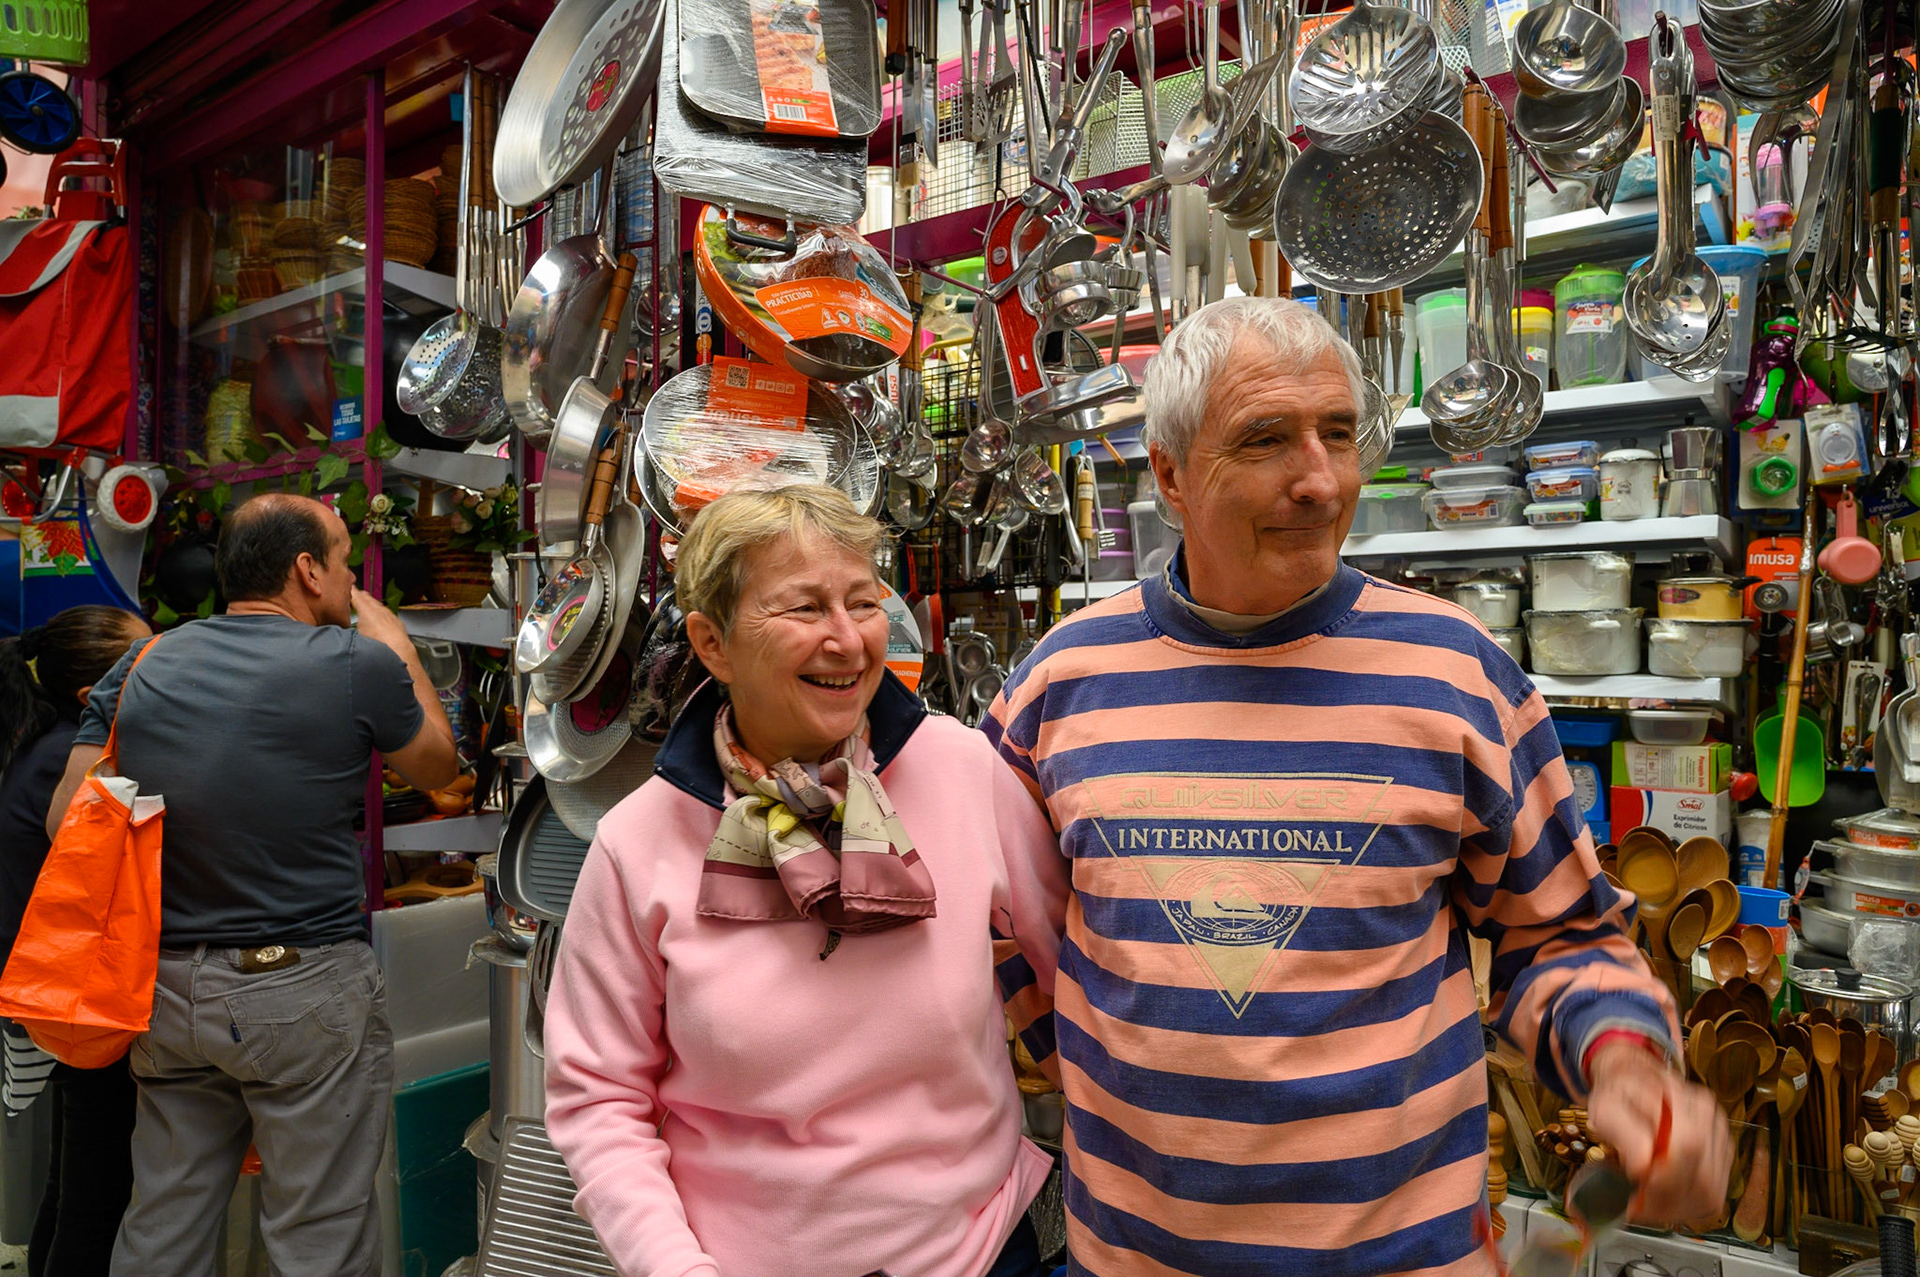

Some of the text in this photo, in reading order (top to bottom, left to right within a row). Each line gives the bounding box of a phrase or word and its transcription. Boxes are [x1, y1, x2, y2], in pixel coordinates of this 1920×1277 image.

[765, 290, 813, 308] PRACTICIDAD
[890, 374, 899, 406] musa
[1749, 553, 1795, 565] imusa
[1673, 813, 1706, 823] Exprimidor
[1673, 821, 1682, 829] de
[1117, 827, 1353, 853] INTERNATIONAL
[1171, 906, 1299, 940] JAPAN BRAZIL CANADA
